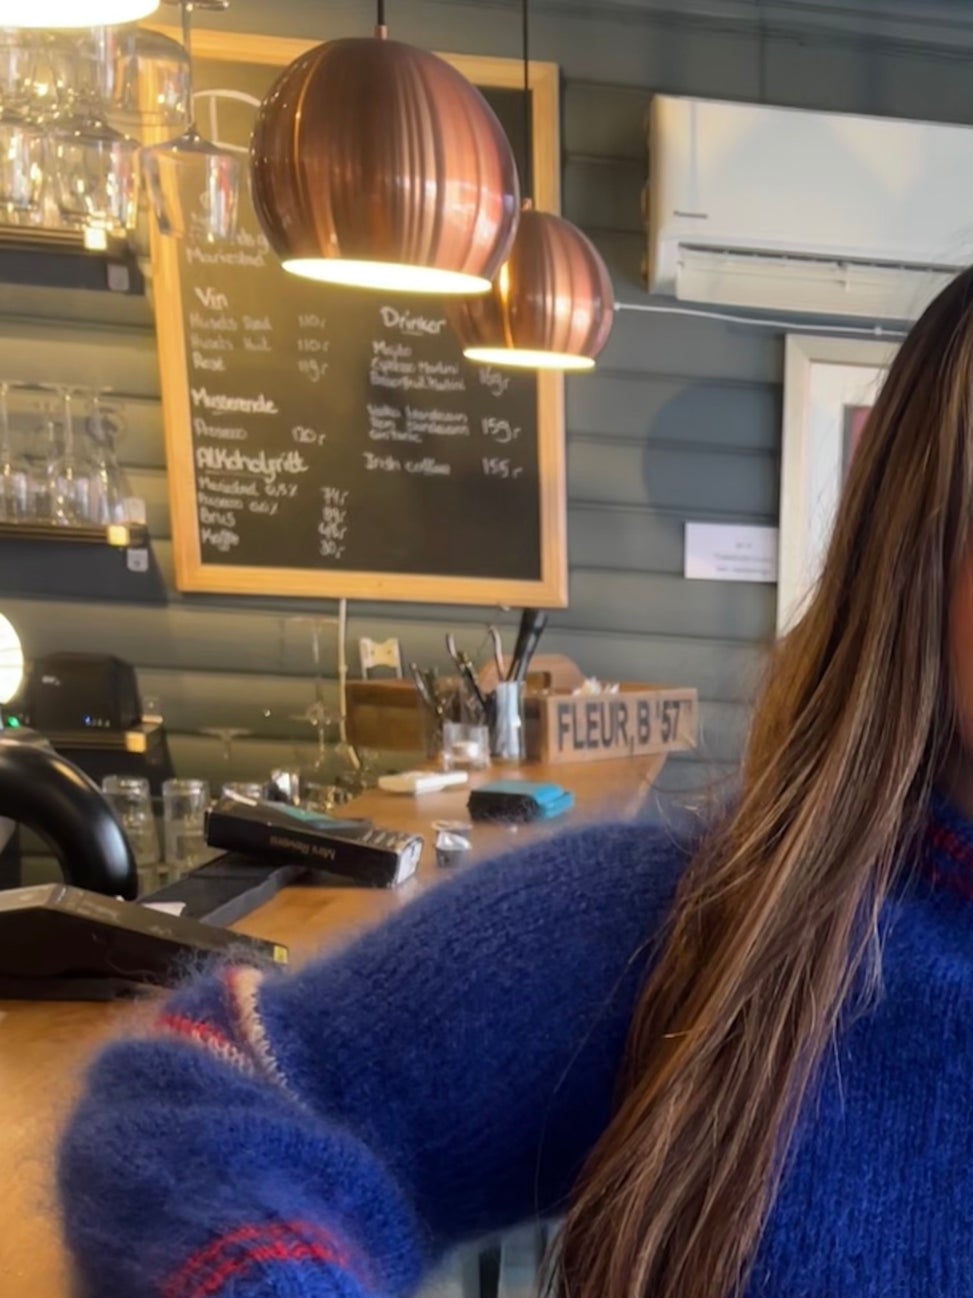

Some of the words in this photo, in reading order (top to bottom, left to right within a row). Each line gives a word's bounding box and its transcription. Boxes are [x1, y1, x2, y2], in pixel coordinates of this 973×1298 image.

[194, 287, 228, 310] Vin
[380, 306, 446, 333] Drinker
[636, 699, 651, 745] B
